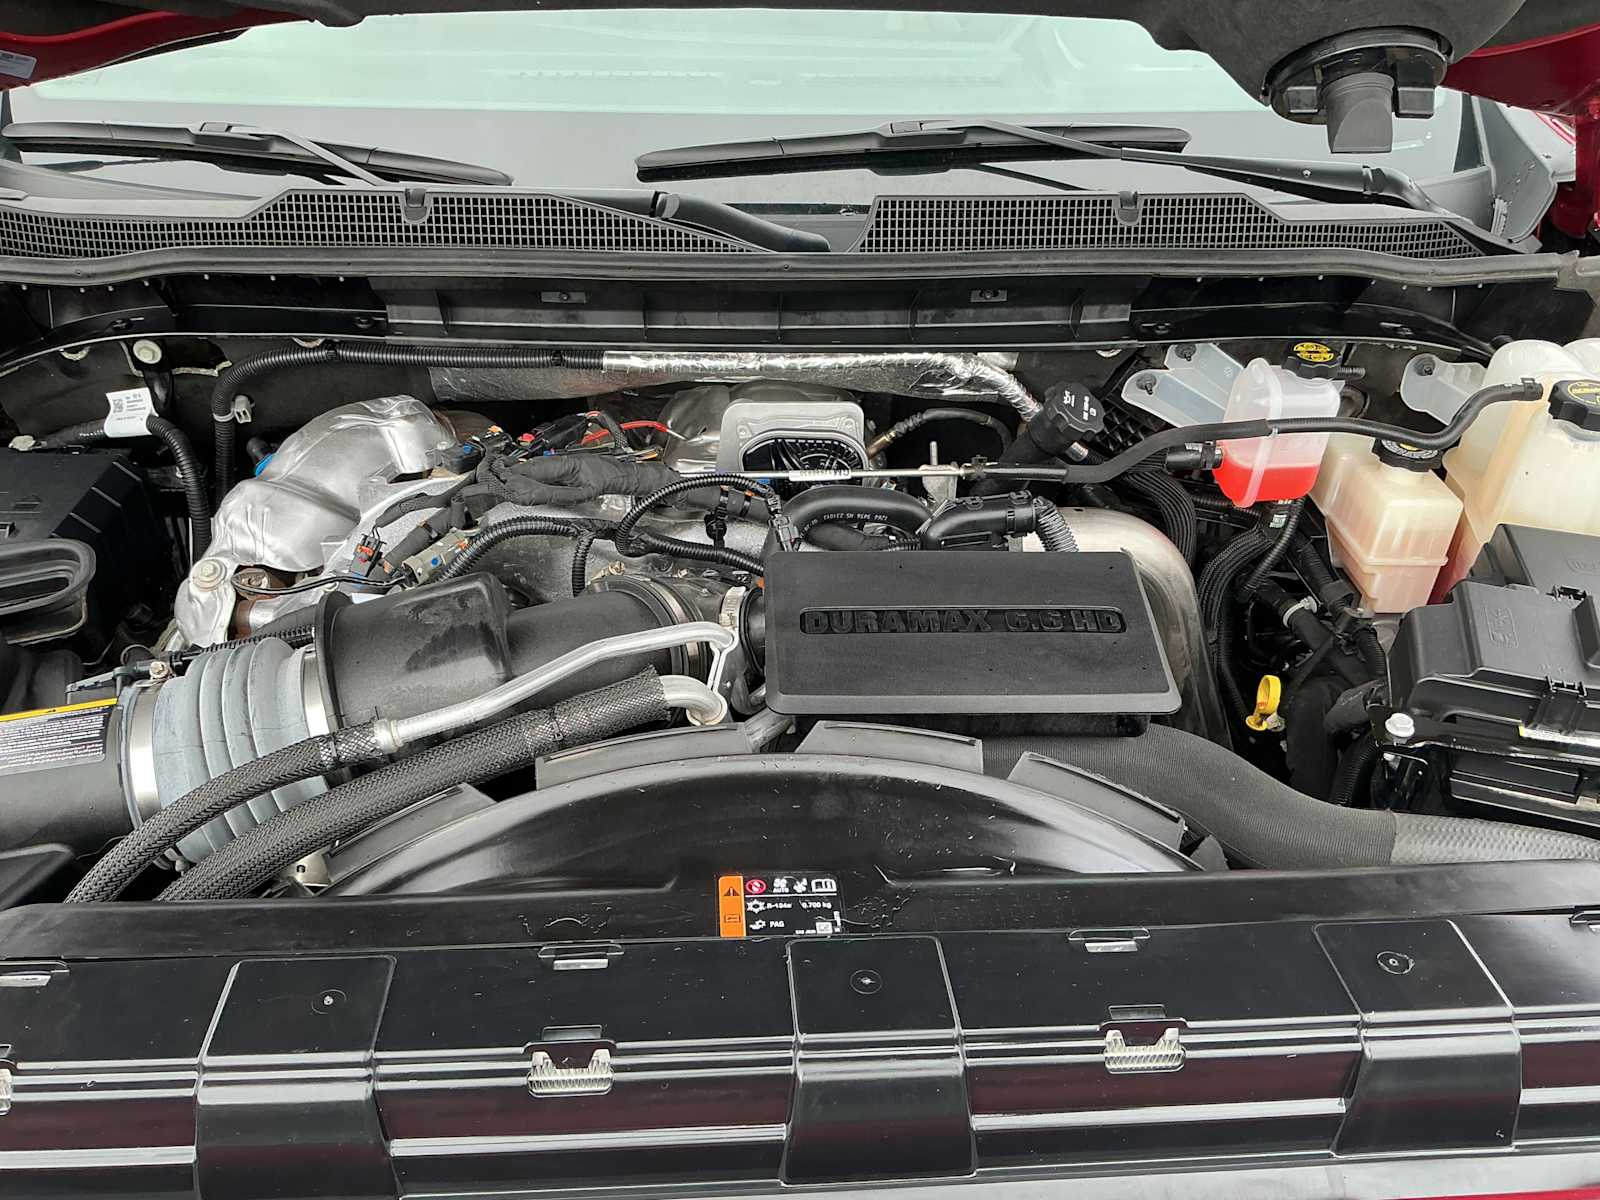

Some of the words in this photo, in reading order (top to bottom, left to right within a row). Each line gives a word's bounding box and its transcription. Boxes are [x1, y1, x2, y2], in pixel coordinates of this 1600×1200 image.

[804, 609, 991, 633] DURAMAX
[1005, 609, 1065, 632] 6.6
[1071, 609, 1123, 631] HD
